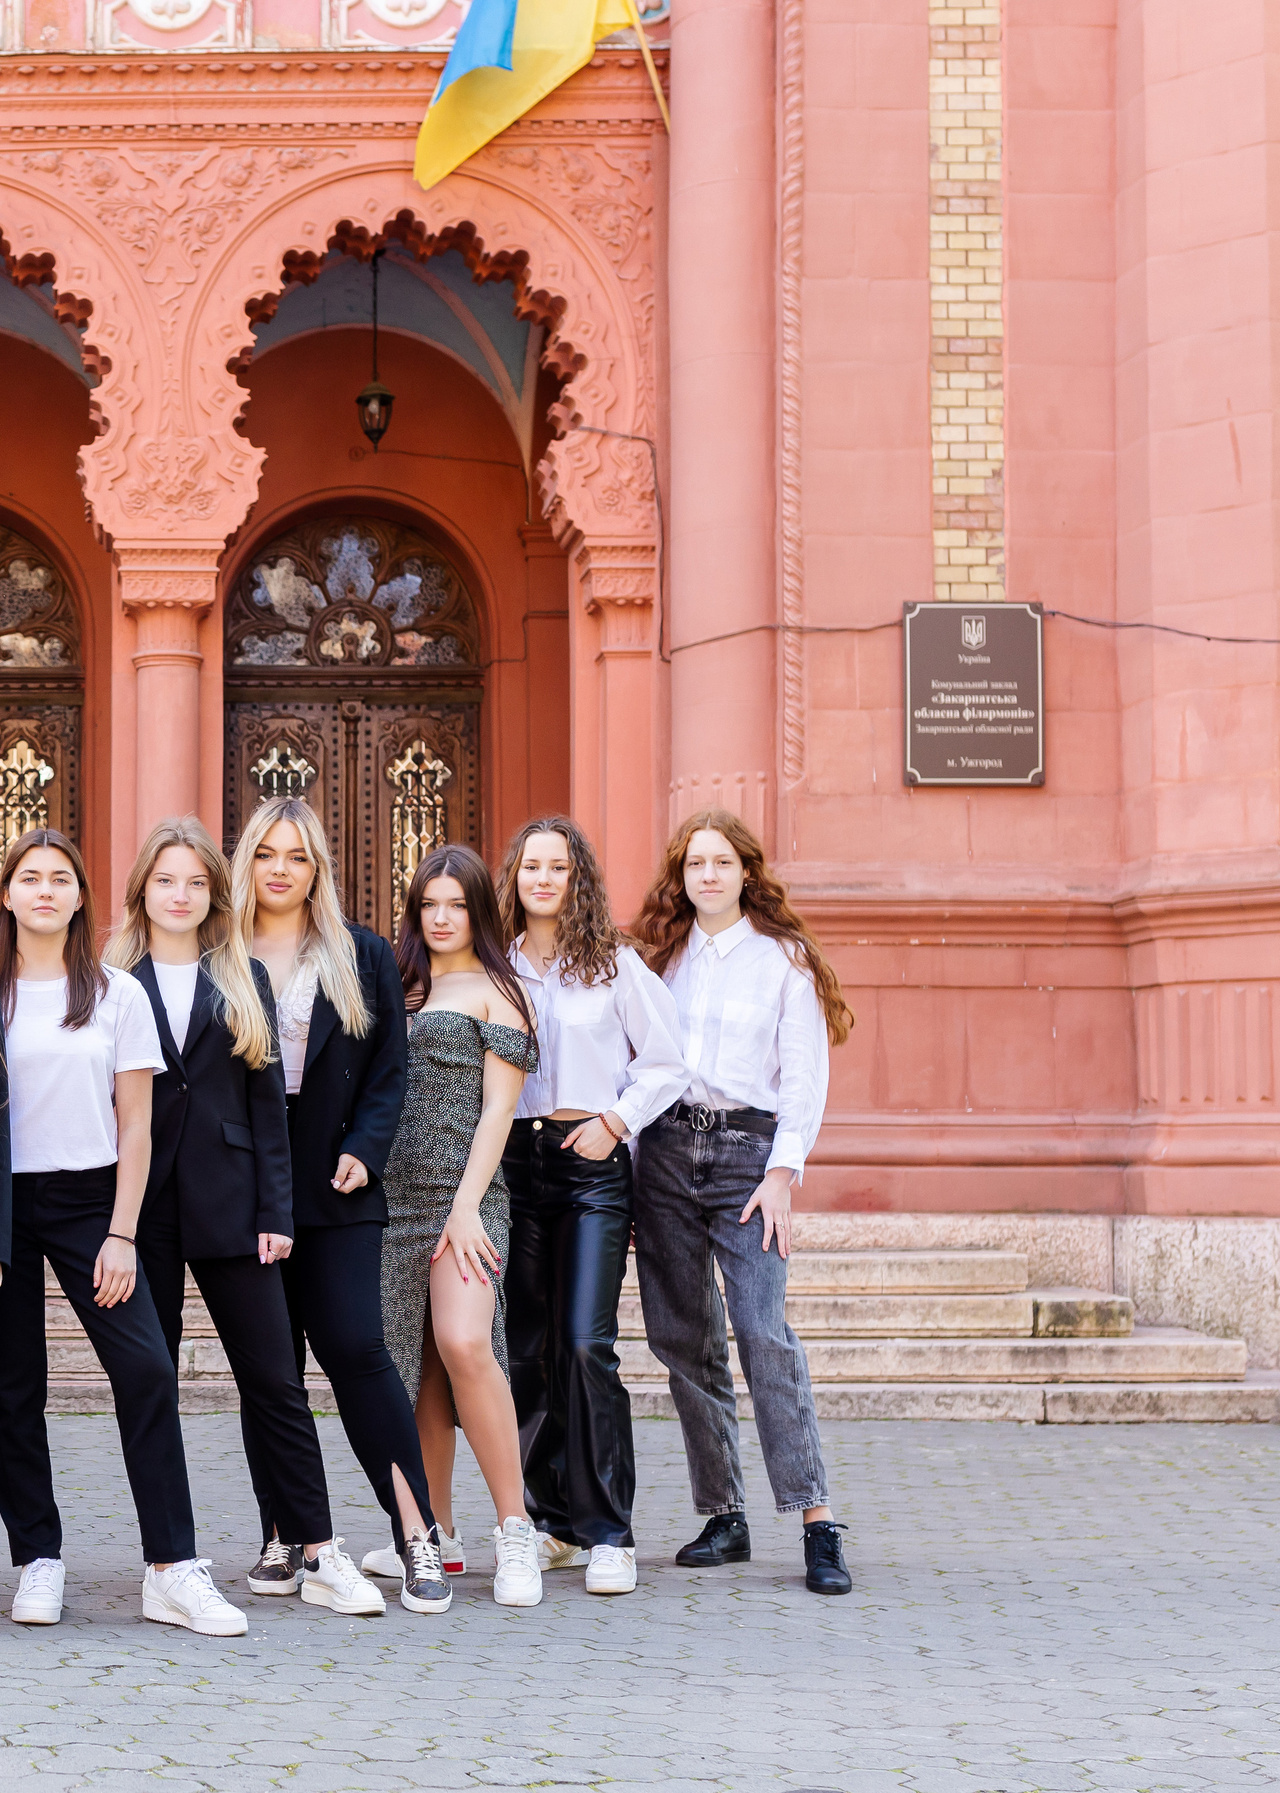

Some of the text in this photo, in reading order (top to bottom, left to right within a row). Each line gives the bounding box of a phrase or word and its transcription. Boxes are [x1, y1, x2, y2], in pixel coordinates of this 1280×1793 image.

[958, 653, 991, 666] Україна
[931, 679, 988, 691] Комунальний
[931, 692, 1018, 706] «Закарпатська
[914, 707, 1035, 721] обласна філармонія»
[947, 756, 1003, 770] м. Ужгород
